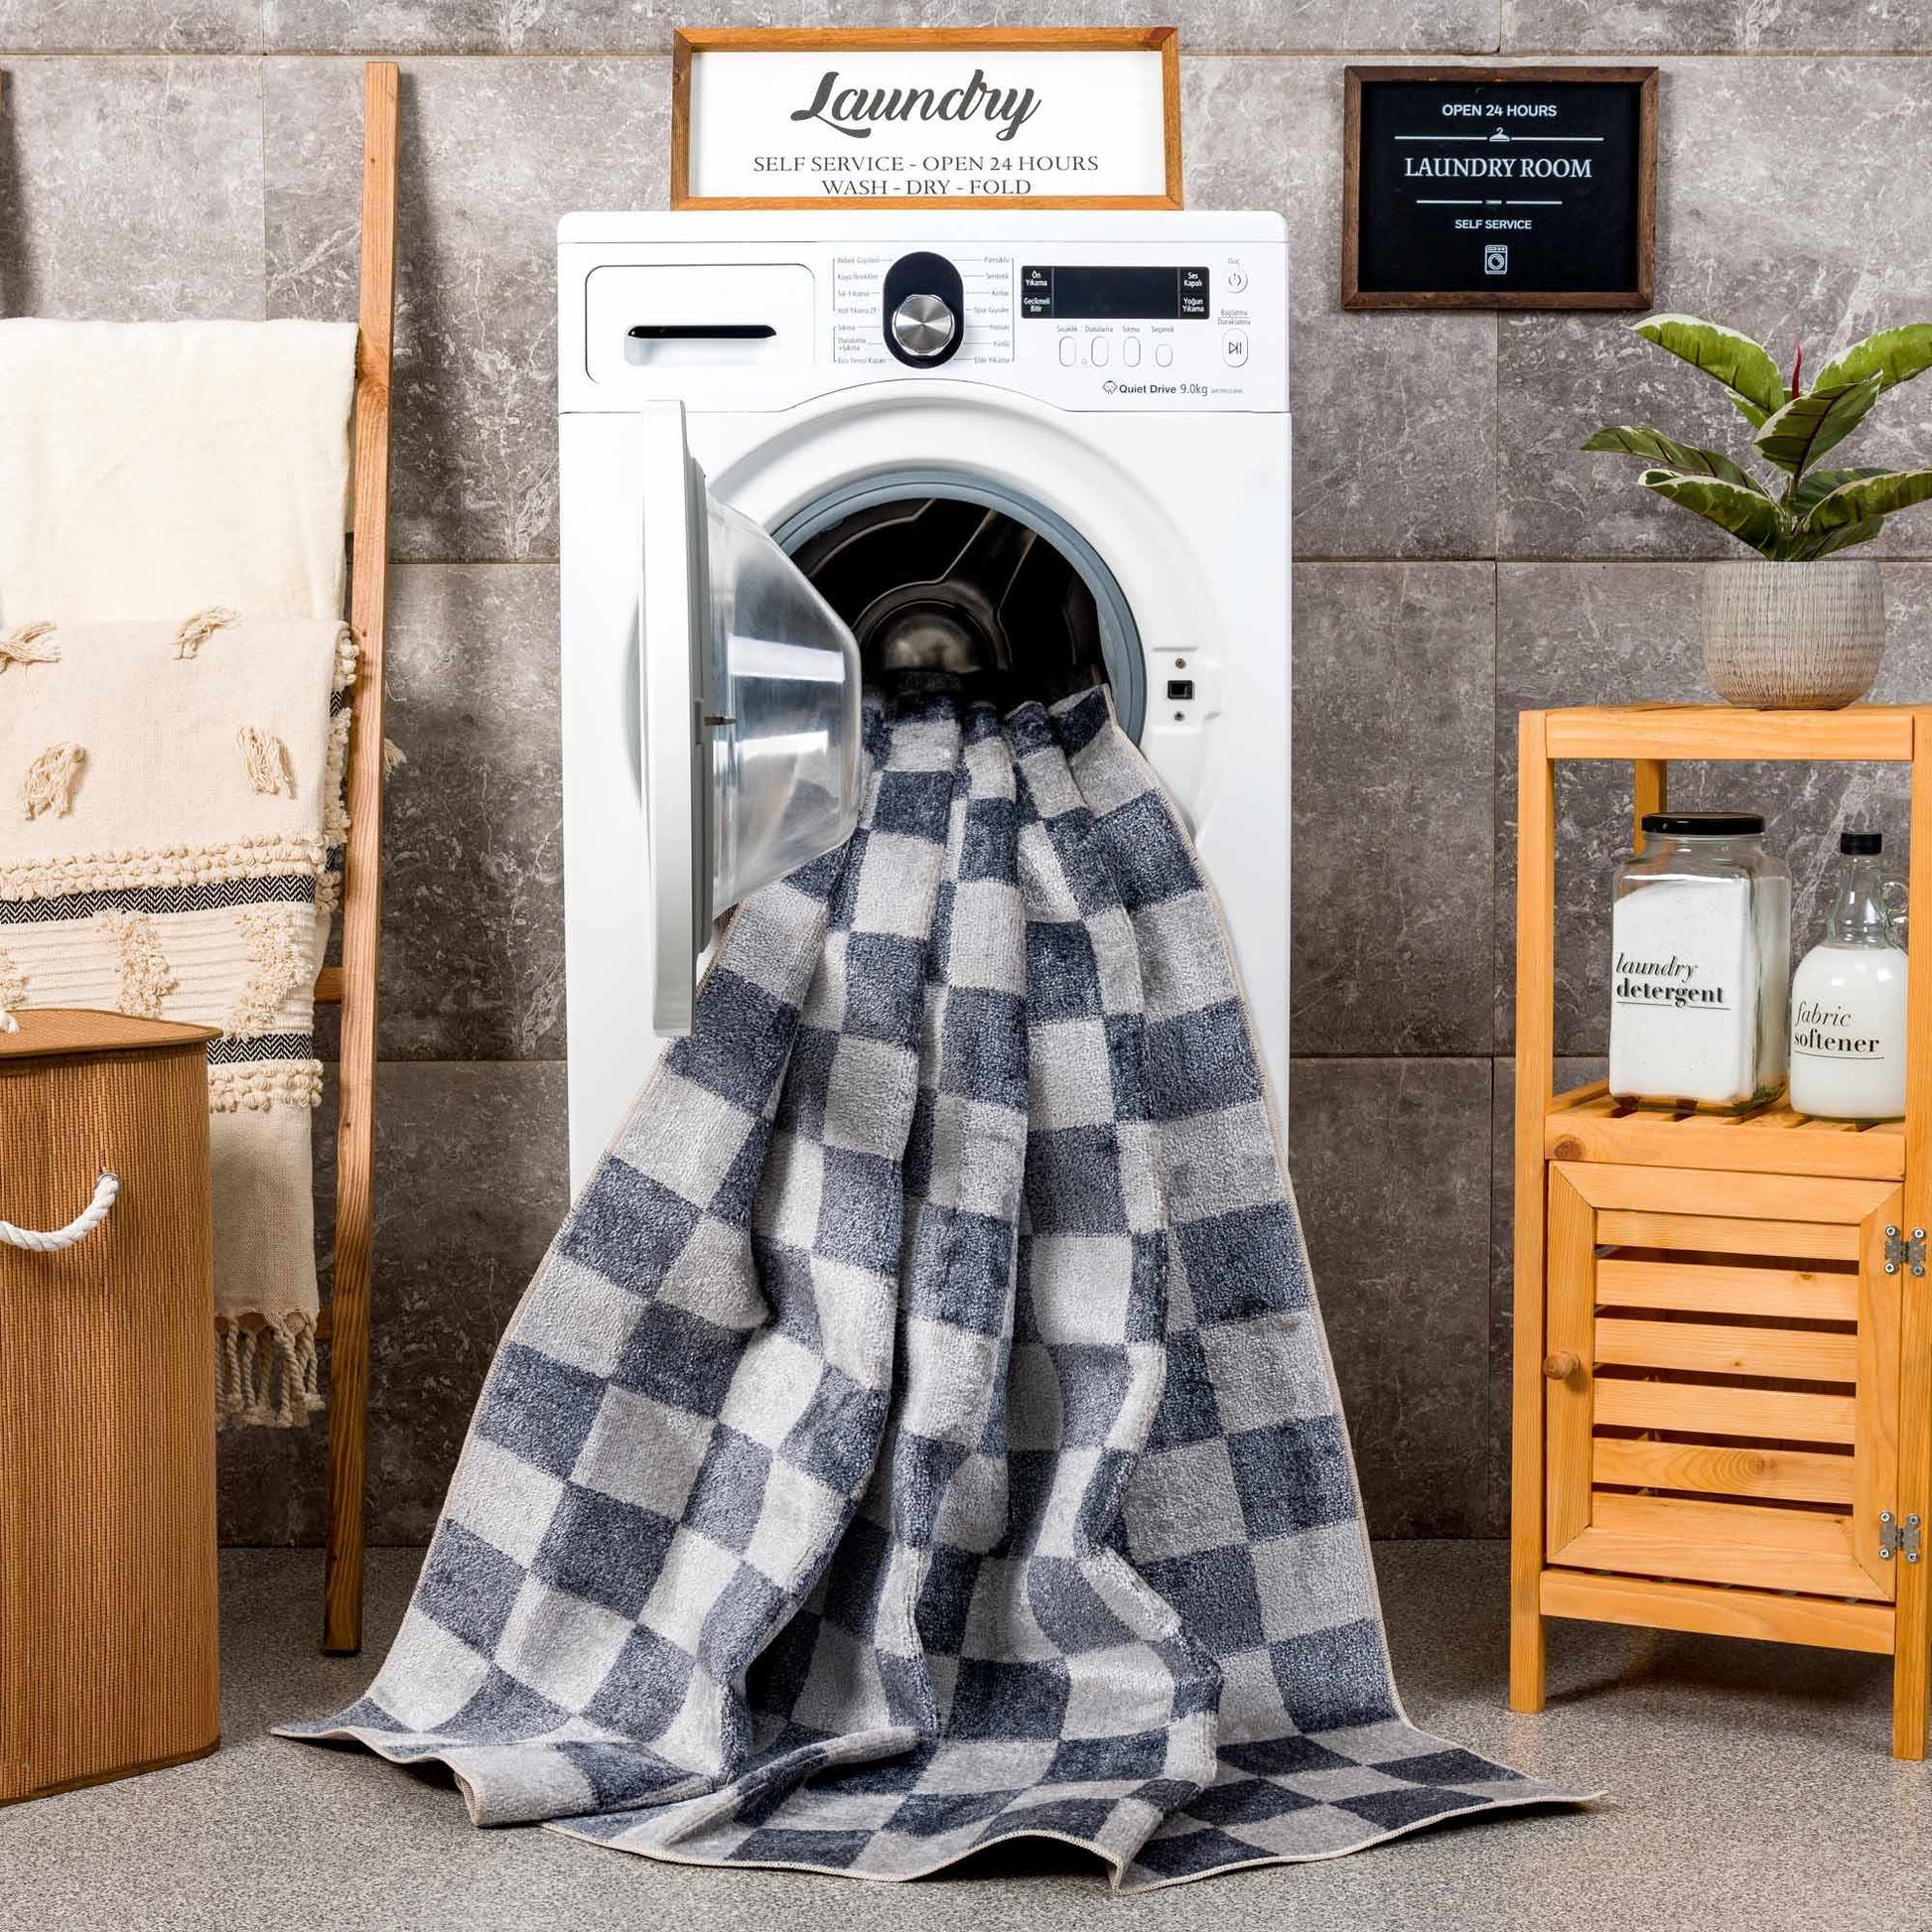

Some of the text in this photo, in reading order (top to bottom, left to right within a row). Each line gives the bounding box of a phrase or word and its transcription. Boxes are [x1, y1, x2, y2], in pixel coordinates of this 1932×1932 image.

[790, 69, 1041, 141] Laundry
[1442, 104, 1558, 117] OPEN 24 HOURS
[754, 156, 805, 172] SELF
[811, 156, 904, 172] SERVICE
[922, 156, 984, 172] OPEN
[989, 156, 1014, 172] 24
[1019, 156, 1099, 172] HOURS
[1404, 158, 1592, 178] LAUNDRY ROOM
[822, 179, 888, 196] WASH
[906, 180, 951, 196] DRY
[969, 180, 1032, 196] FOLD
[1454, 219, 1532, 229] SELF SERVICE
[1183, 279, 1202, 289] Kapalı
[1119, 385, 1147, 394] Quiet
[1150, 385, 1176, 394] Drive
[1179, 383, 1208, 396] 9.0kg
[1616, 953, 1698, 983] laundry
[1616, 978, 1725, 1009] detergent
[1795, 1001, 1852, 1028] fabric
[1794, 1029, 1880, 1052] softener
